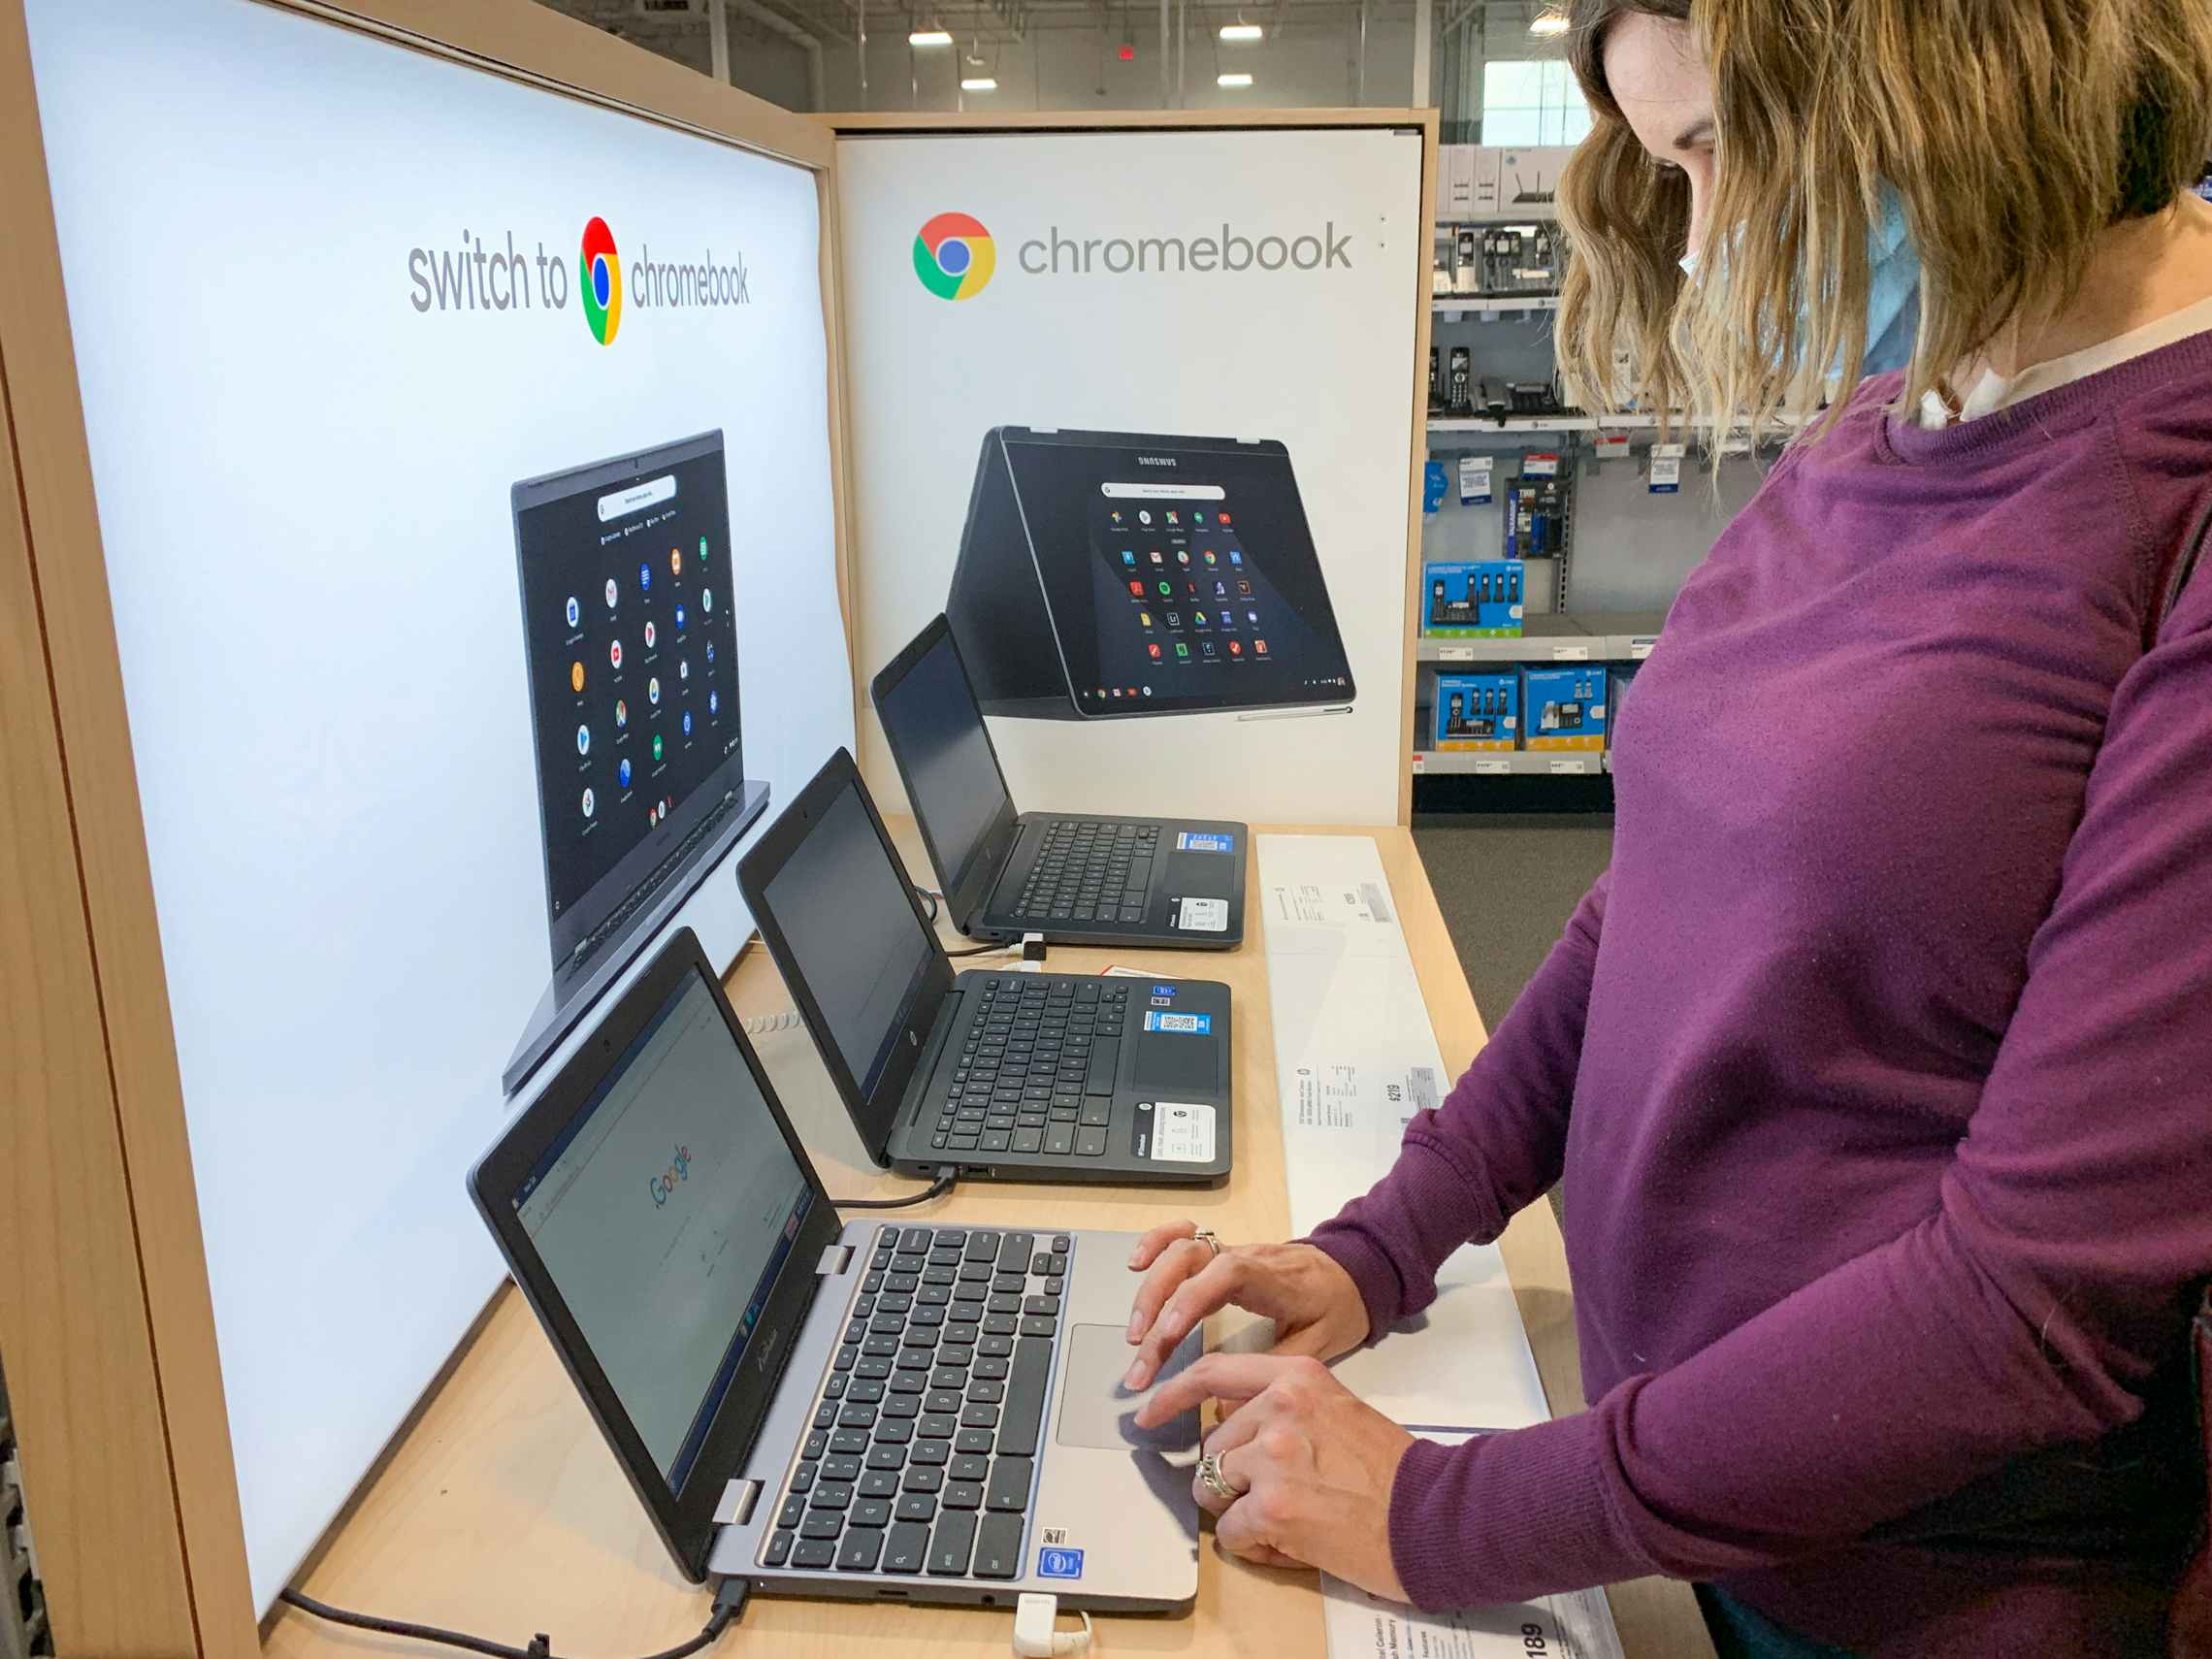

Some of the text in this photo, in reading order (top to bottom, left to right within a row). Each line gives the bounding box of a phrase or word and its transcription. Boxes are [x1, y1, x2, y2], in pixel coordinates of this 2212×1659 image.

[408, 228, 568, 312] switch to
[1019, 221, 1353, 274] chromebook
[632, 243, 750, 309] chromebook
[1138, 457, 1177, 467] SAMSUNG
[1387, 1084, 1401, 1102] $219
[650, 1143, 691, 1205] Google
[1521, 1623, 1548, 1658] 189
